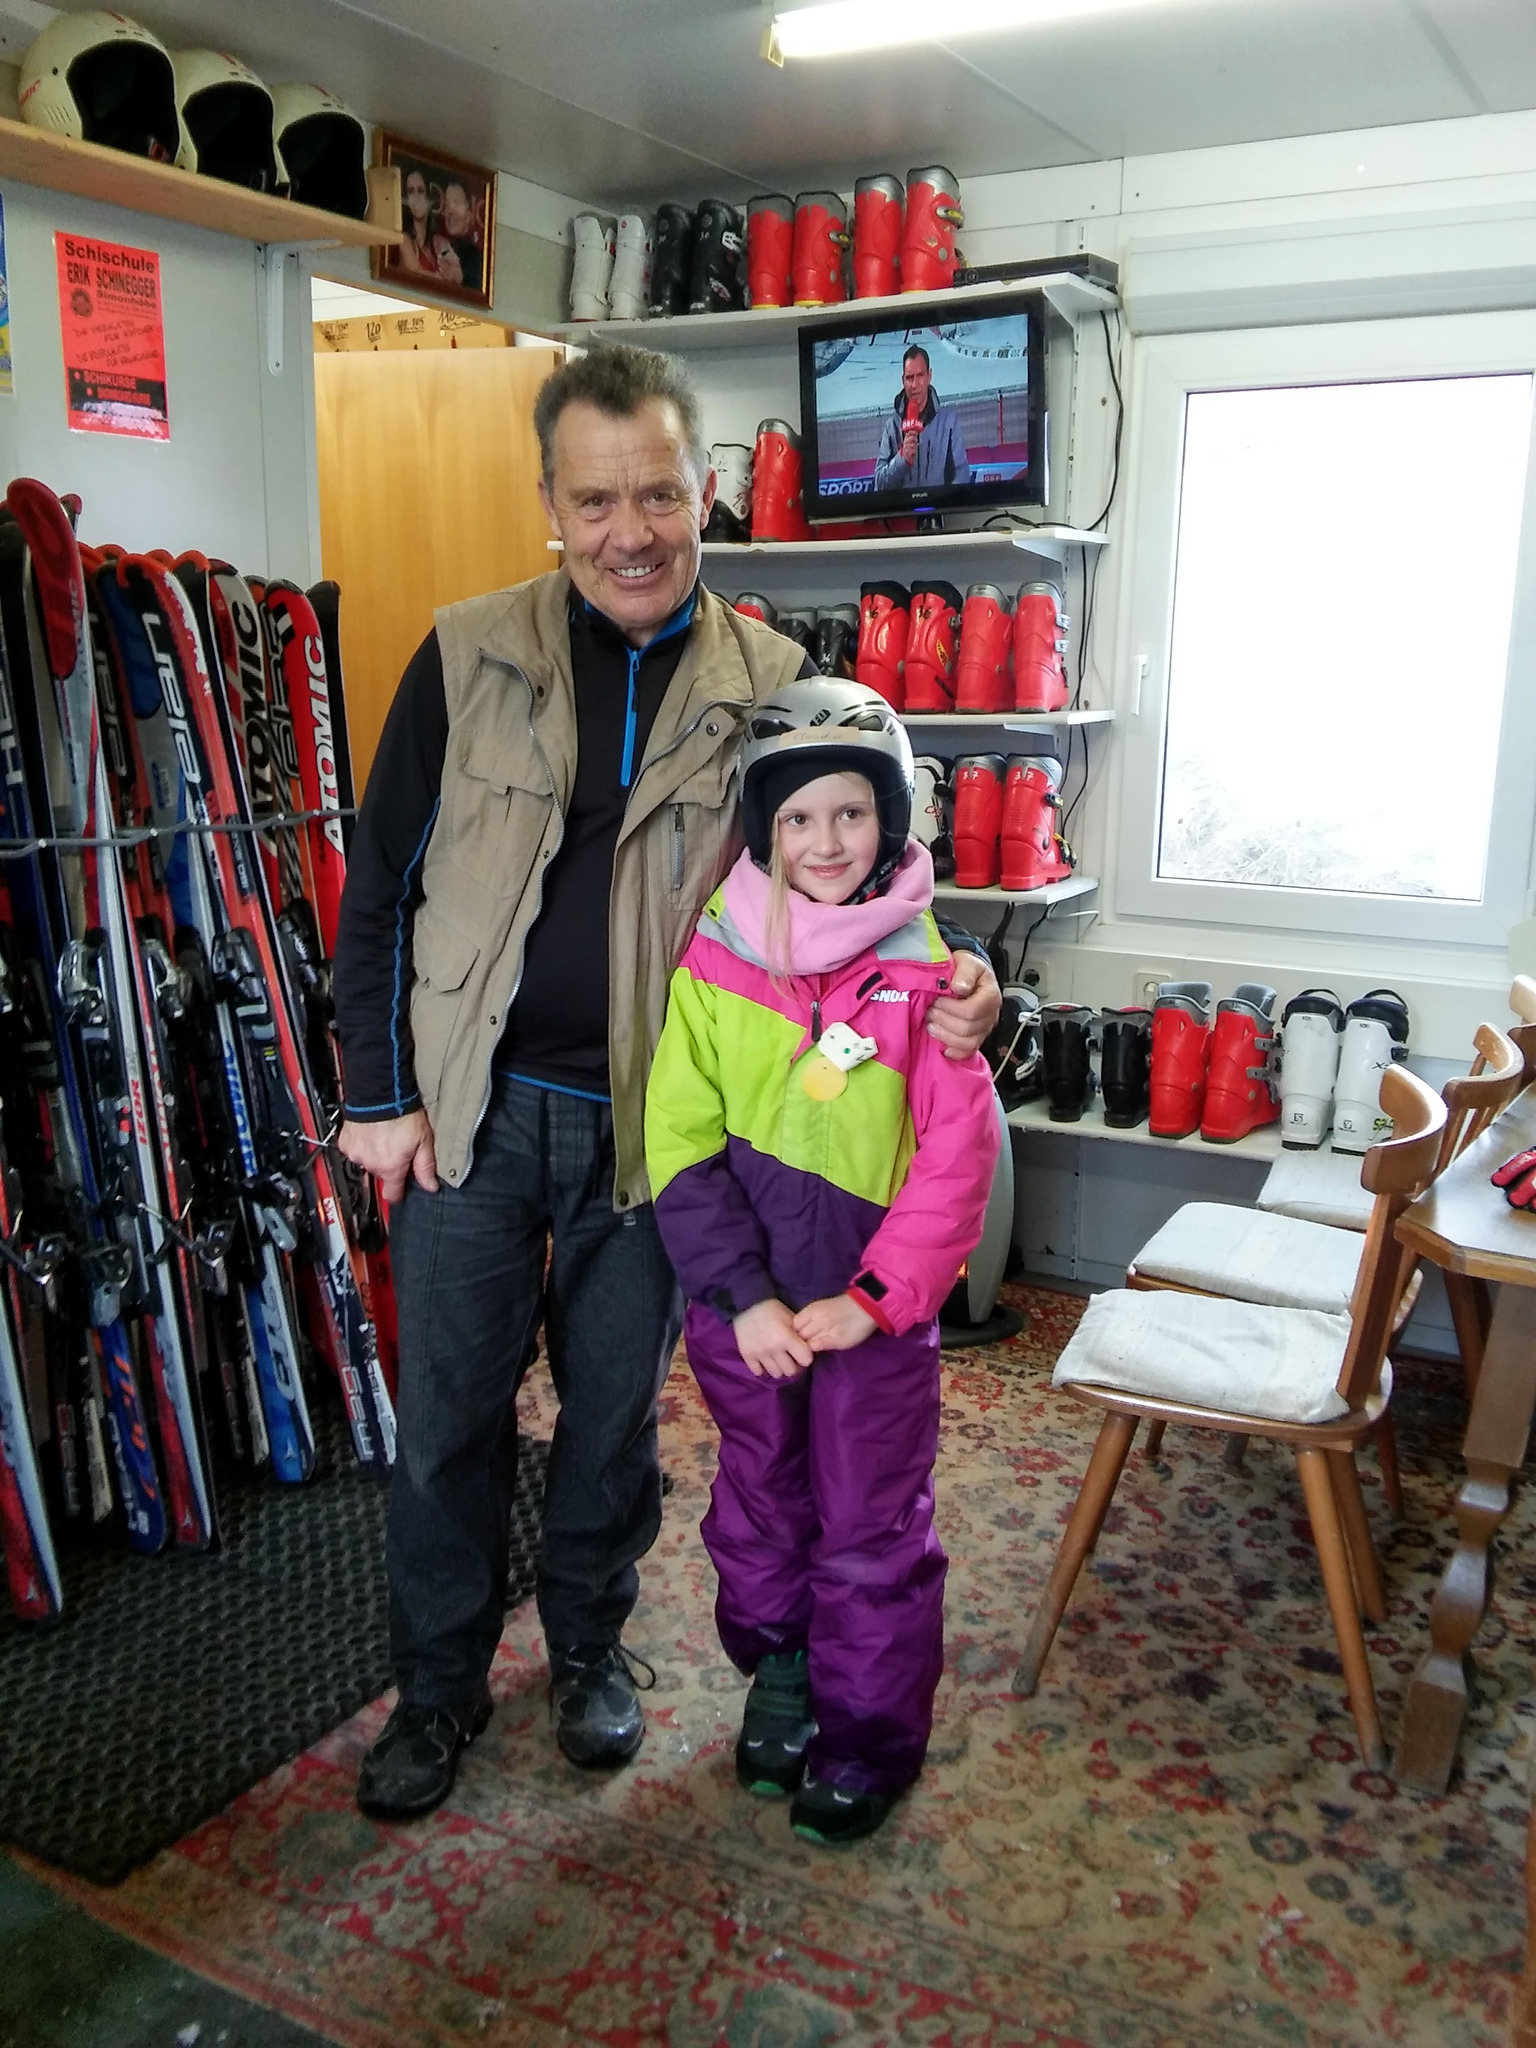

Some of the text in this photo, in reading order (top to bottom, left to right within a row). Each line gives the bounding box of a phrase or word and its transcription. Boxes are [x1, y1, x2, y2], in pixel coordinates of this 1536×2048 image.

[65, 239, 155, 273] Schischule
[66, 261, 157, 299] ERIK SCHINEGGER
[366, 322, 381, 337] 120
[818, 479, 873, 496] SPORT
[142, 612, 202, 784] elan
[304, 634, 345, 856] ATOMIC
[1014, 771, 1035, 782] 37
